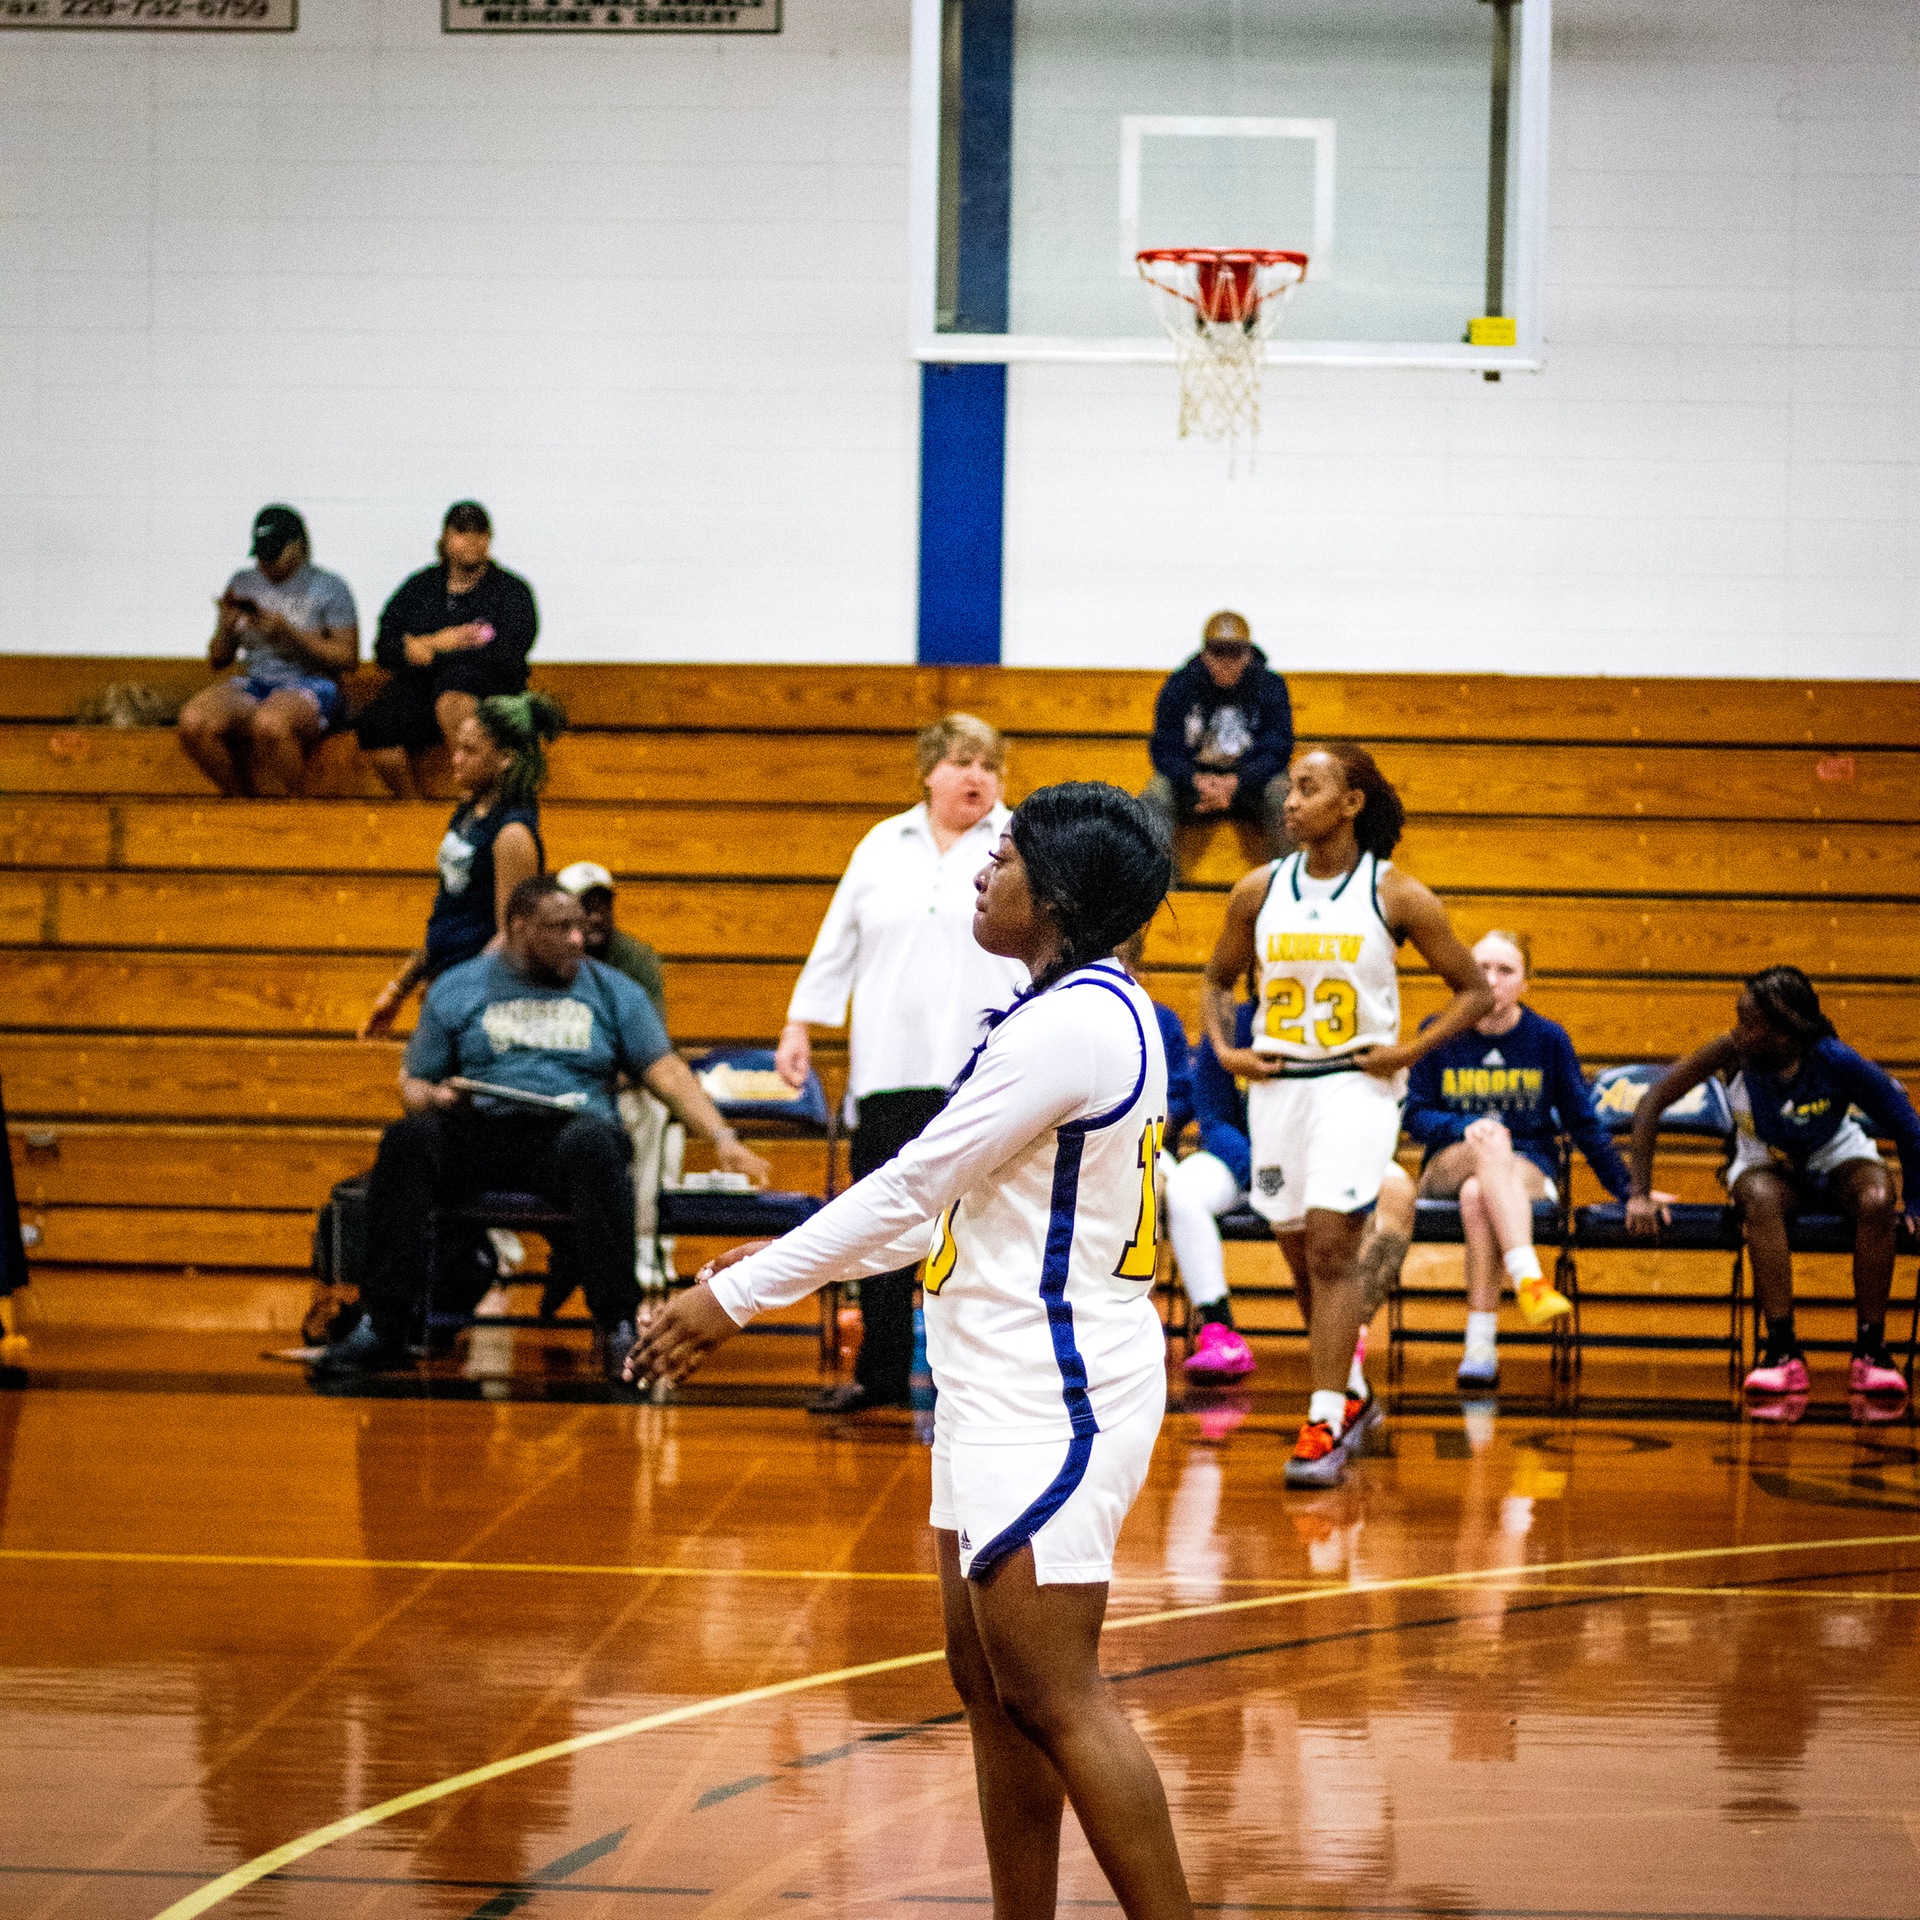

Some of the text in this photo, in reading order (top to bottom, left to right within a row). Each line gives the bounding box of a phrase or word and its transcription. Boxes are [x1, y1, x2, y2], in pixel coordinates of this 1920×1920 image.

[483, 9, 738, 23] MEDICINE & SURGERY
[1266, 932, 1364, 963] ANDREW
[1265, 977, 1359, 1049] 23
